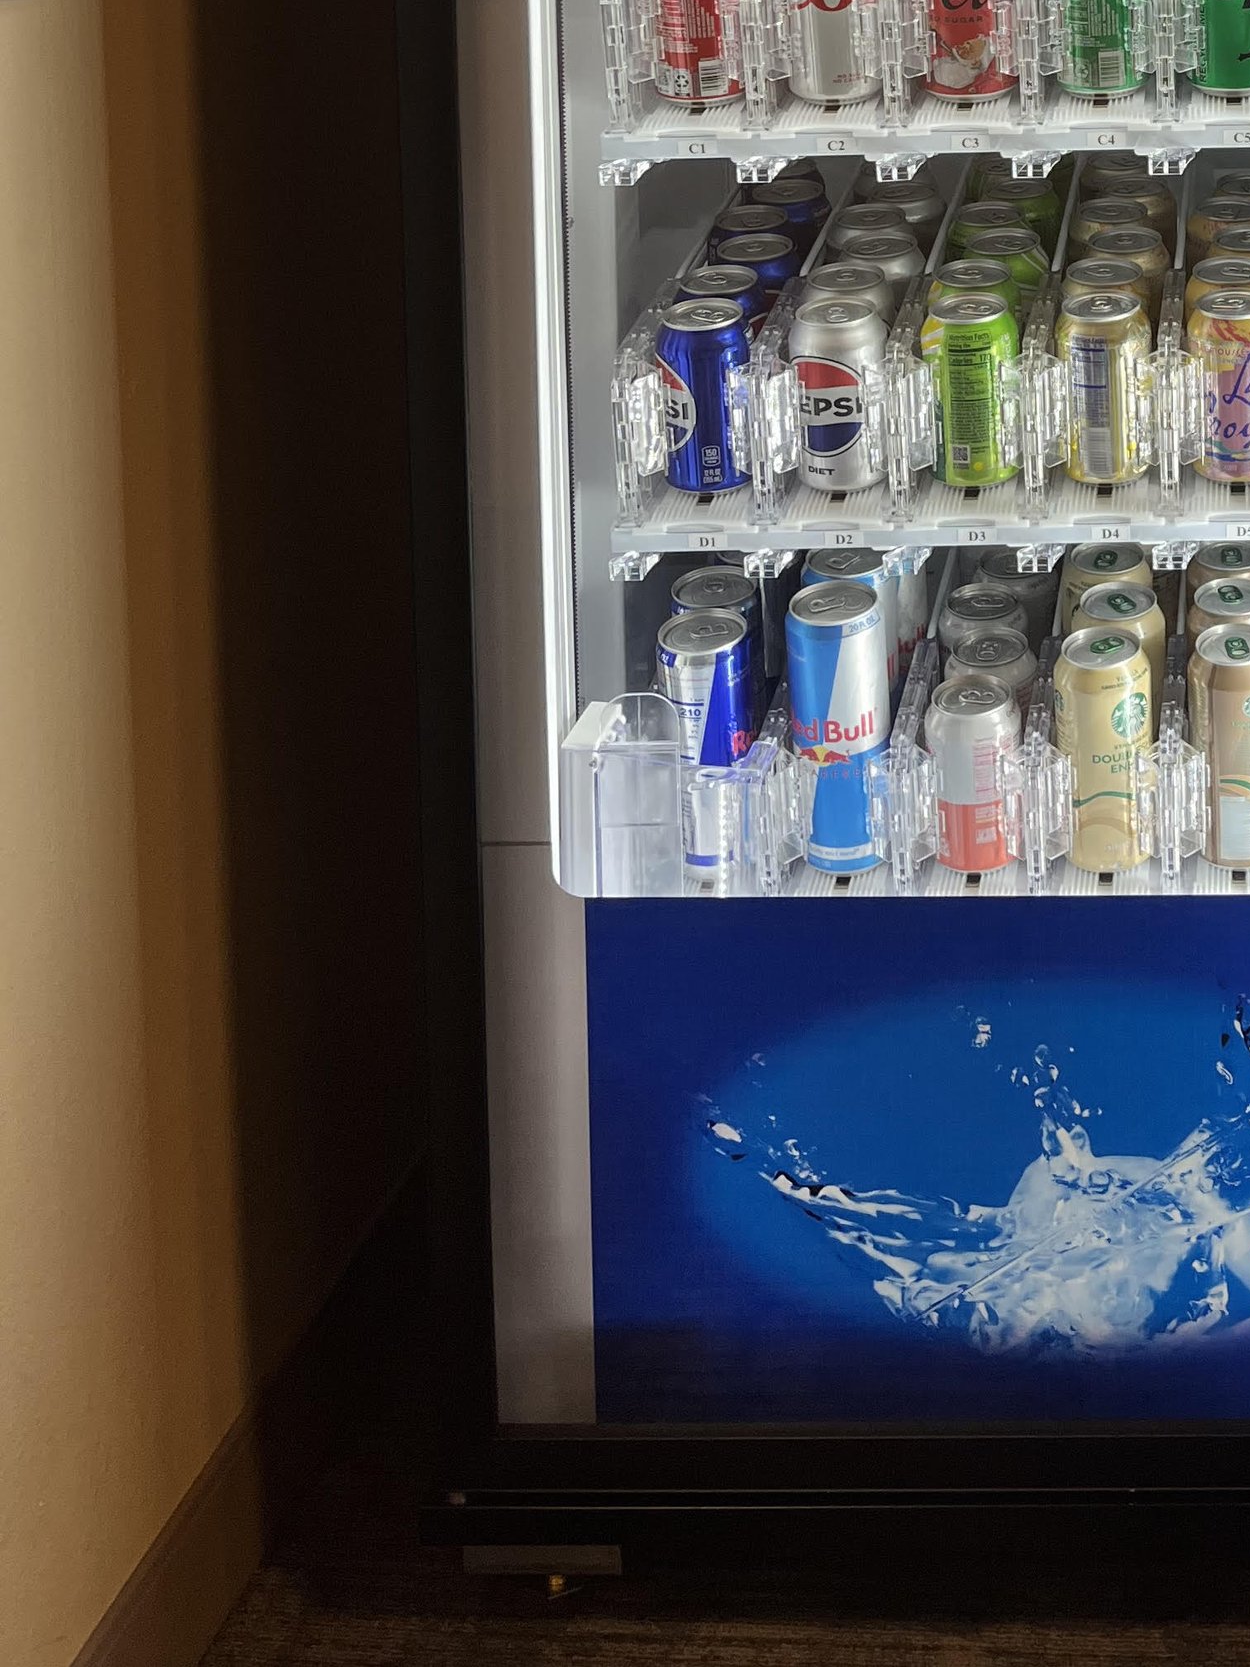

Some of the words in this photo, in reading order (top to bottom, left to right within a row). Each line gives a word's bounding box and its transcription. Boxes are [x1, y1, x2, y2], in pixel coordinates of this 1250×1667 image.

[961, 136, 980, 149] C3
[1097, 133, 1116, 146] C4
[1233, 131, 1250, 144] C5
[688, 142, 706, 155] C1
[827, 139, 846, 152] C2
[705, 448, 717, 457] 150
[808, 465, 836, 476] DIET
[835, 533, 853, 545] D2
[968, 530, 986, 542] D3
[1101, 527, 1120, 540] D4
[699, 536, 716, 548] D1
[680, 707, 701, 717] 210
[824, 710, 874, 744] Bull
